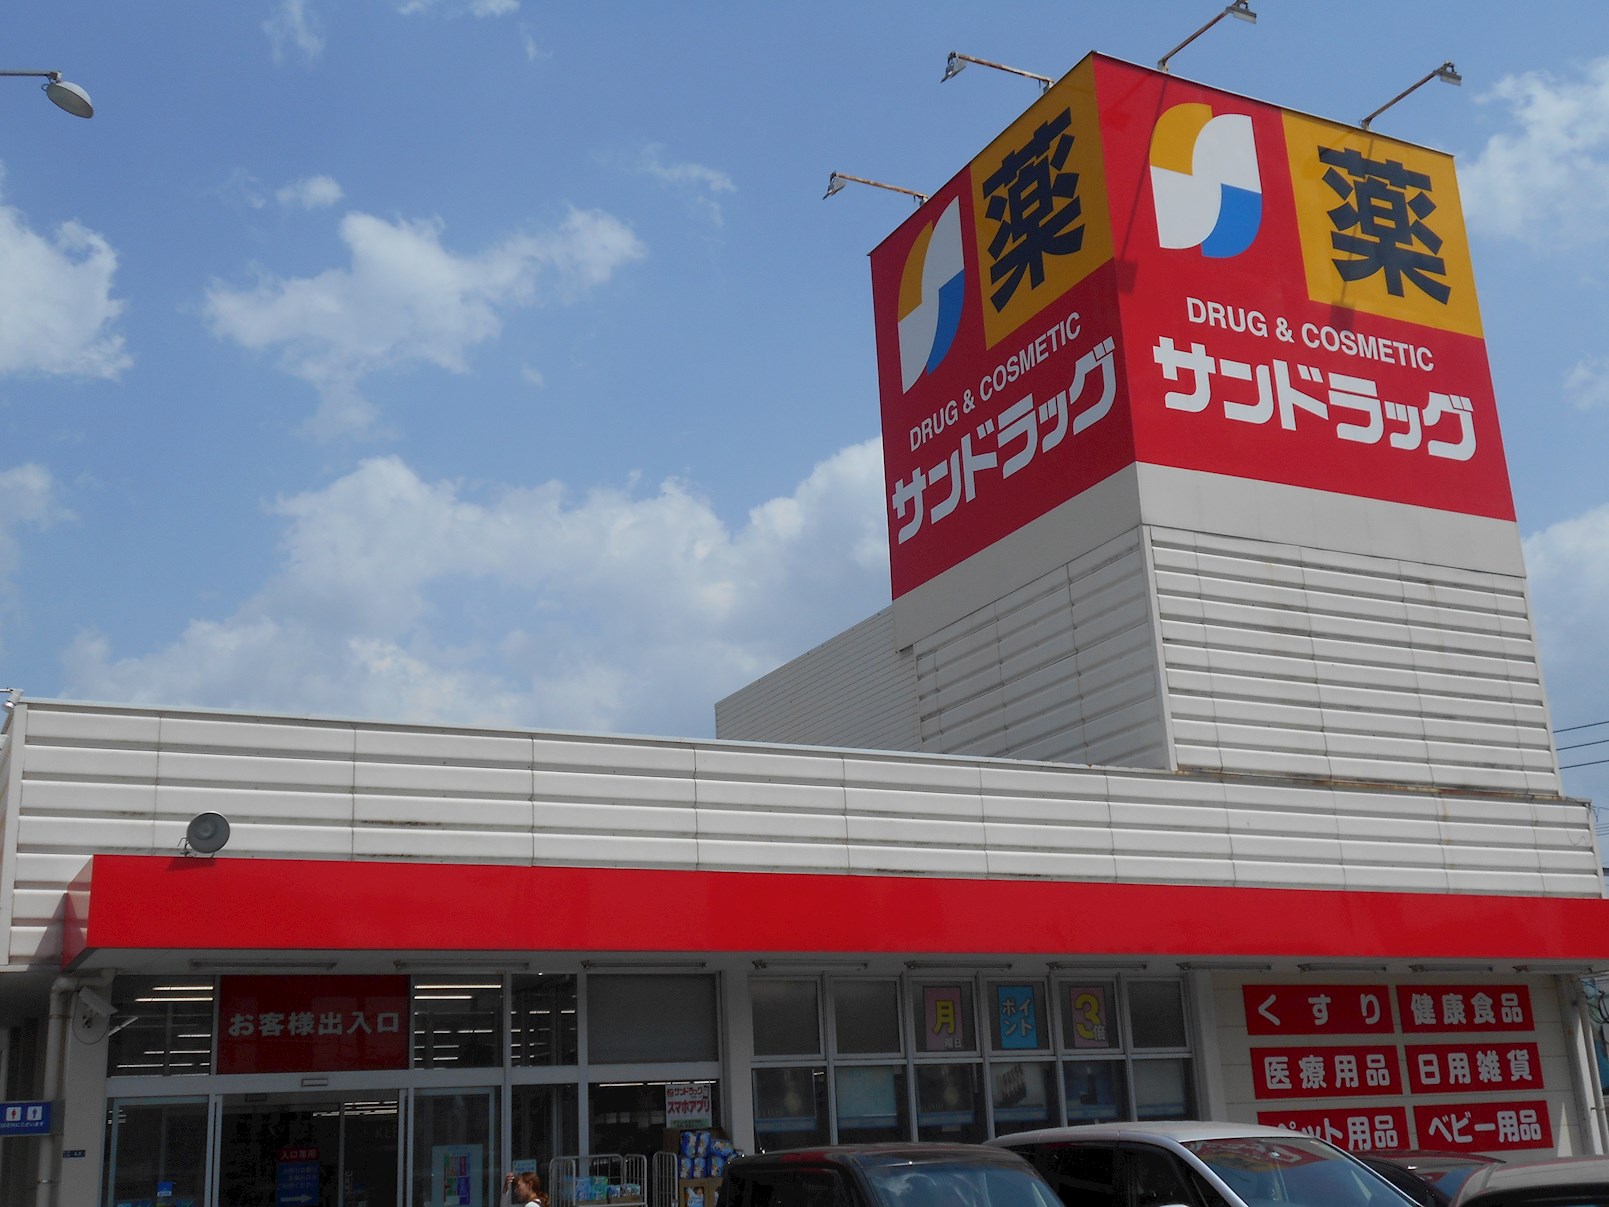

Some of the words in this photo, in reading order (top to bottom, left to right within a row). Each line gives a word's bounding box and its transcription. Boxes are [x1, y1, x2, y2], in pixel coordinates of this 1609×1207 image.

[983, 107, 1084, 312] 薬
[1317, 145, 1451, 304] 薬
[1186, 297, 1268, 337] DRUG
[1275, 317, 1295, 343] &
[1301, 323, 1435, 372] COSMETIC
[909, 400, 959, 452] DRUG
[963, 389, 975, 414] &
[979, 311, 1081, 402] COSMETIC
[1153, 336, 1477, 462] サンドラッグ
[892, 336, 1117, 545] サンドラッグ
[228, 1011, 399, 1037] お客様出入口
[933, 999, 956, 1035] 月
[1258, 994, 1381, 1026] くすり
[1410, 992, 1524, 1026] 健康食品
[1264, 1054, 1391, 1090] 医療用品
[1418, 1049, 1533, 1085] 日用雑貨
[667, 1099, 710, 1114] スマホアプリ
[1428, 1109, 1542, 1144] ベビー用品
